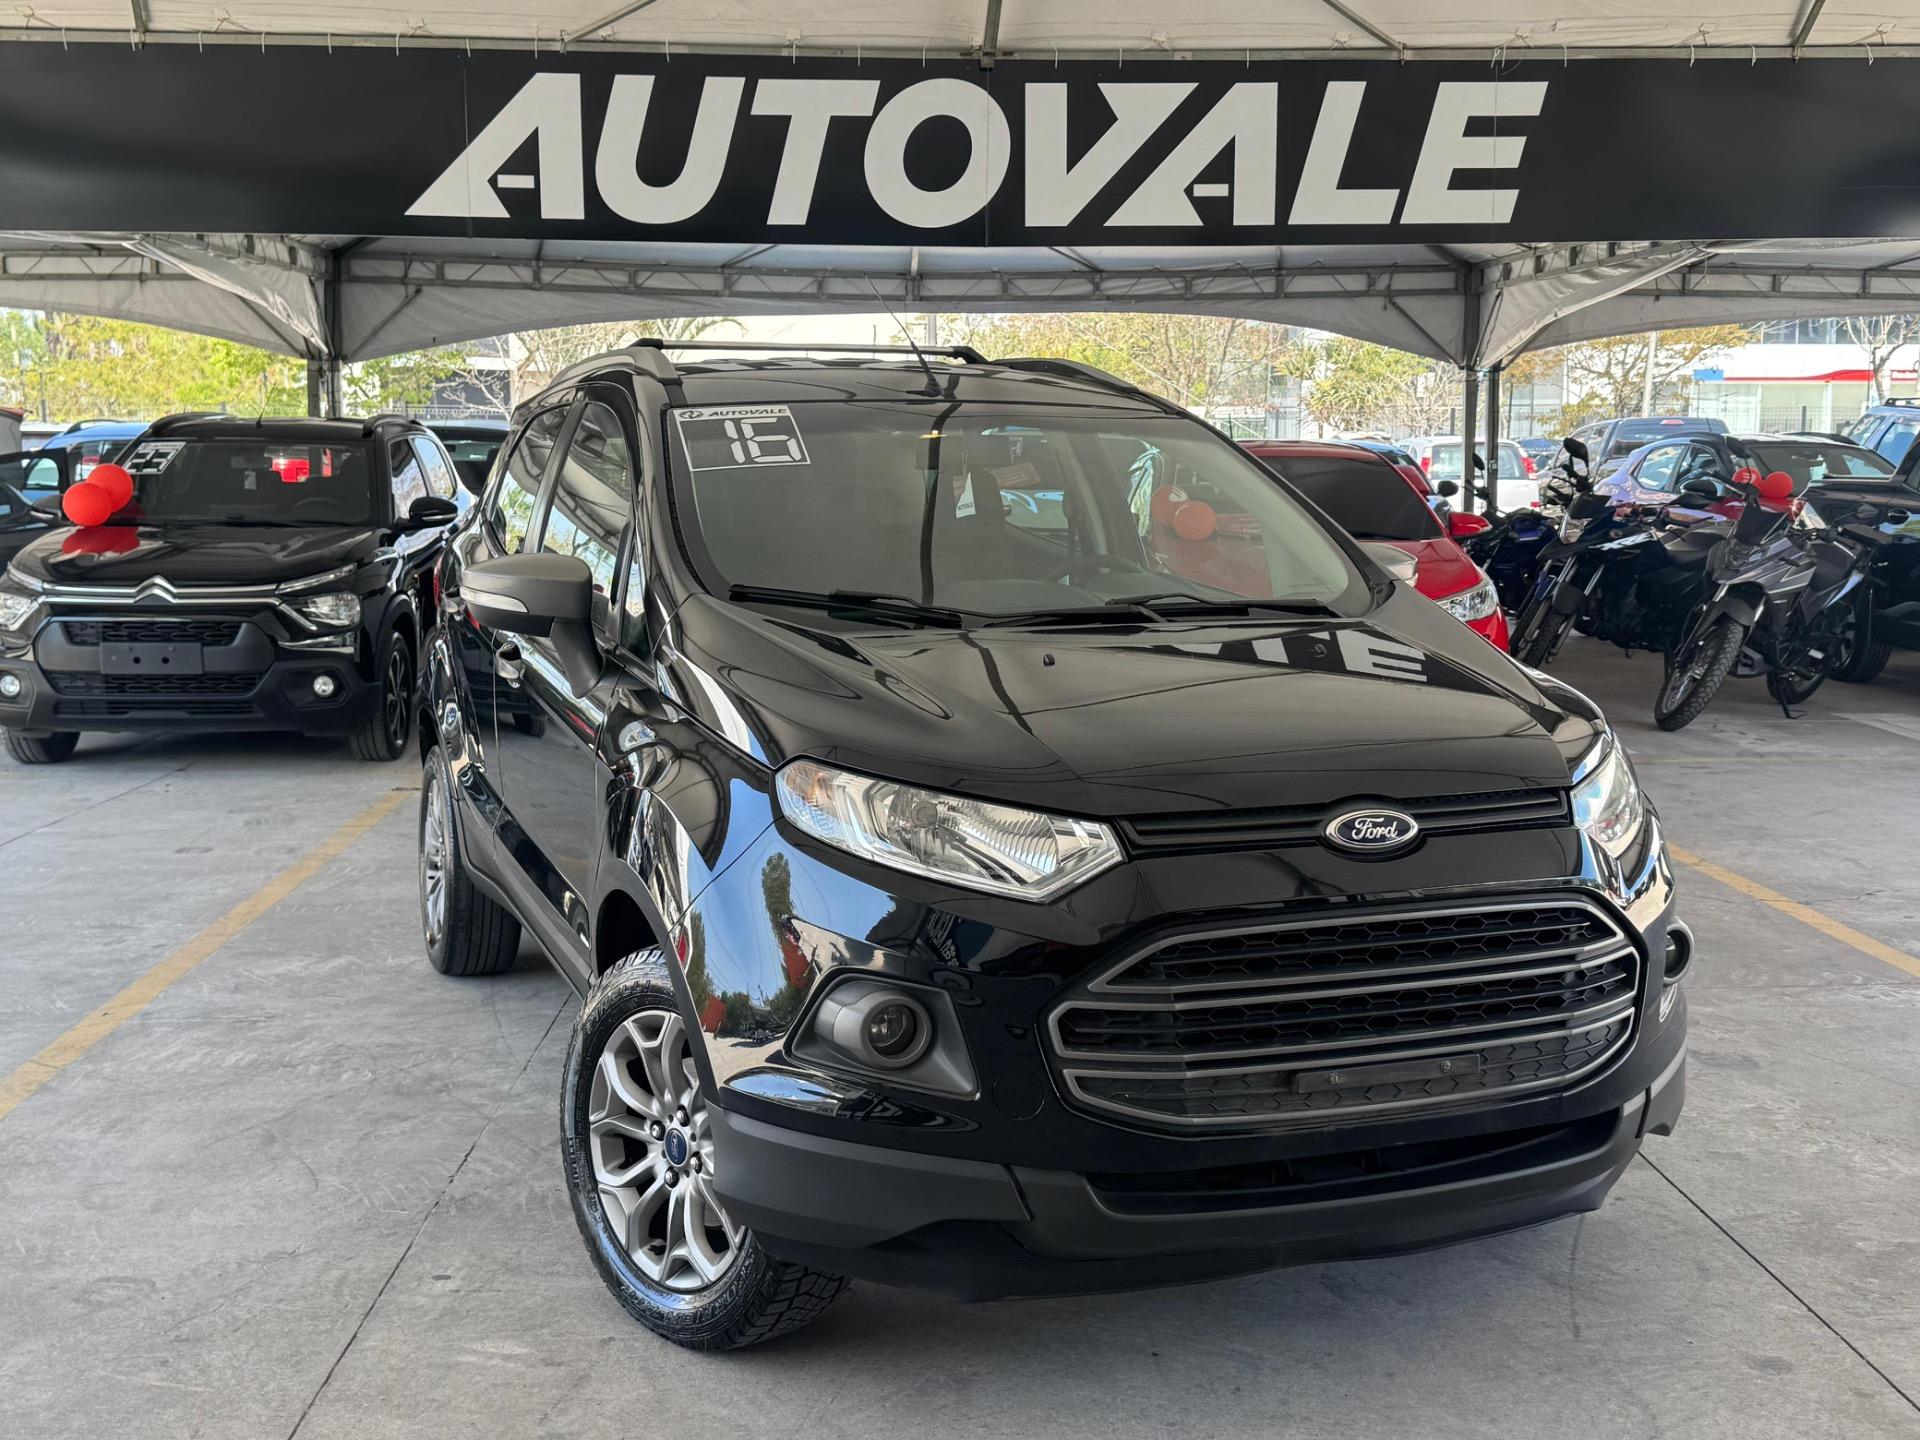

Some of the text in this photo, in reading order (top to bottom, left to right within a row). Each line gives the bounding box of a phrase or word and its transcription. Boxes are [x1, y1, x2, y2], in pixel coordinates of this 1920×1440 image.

[405, 73, 1548, 228] AUTOVALE
[707, 408, 788, 417] AUTOVALE
[724, 417, 802, 464] 16
[125, 449, 177, 473] 23
[1351, 817, 1398, 840] Ford
